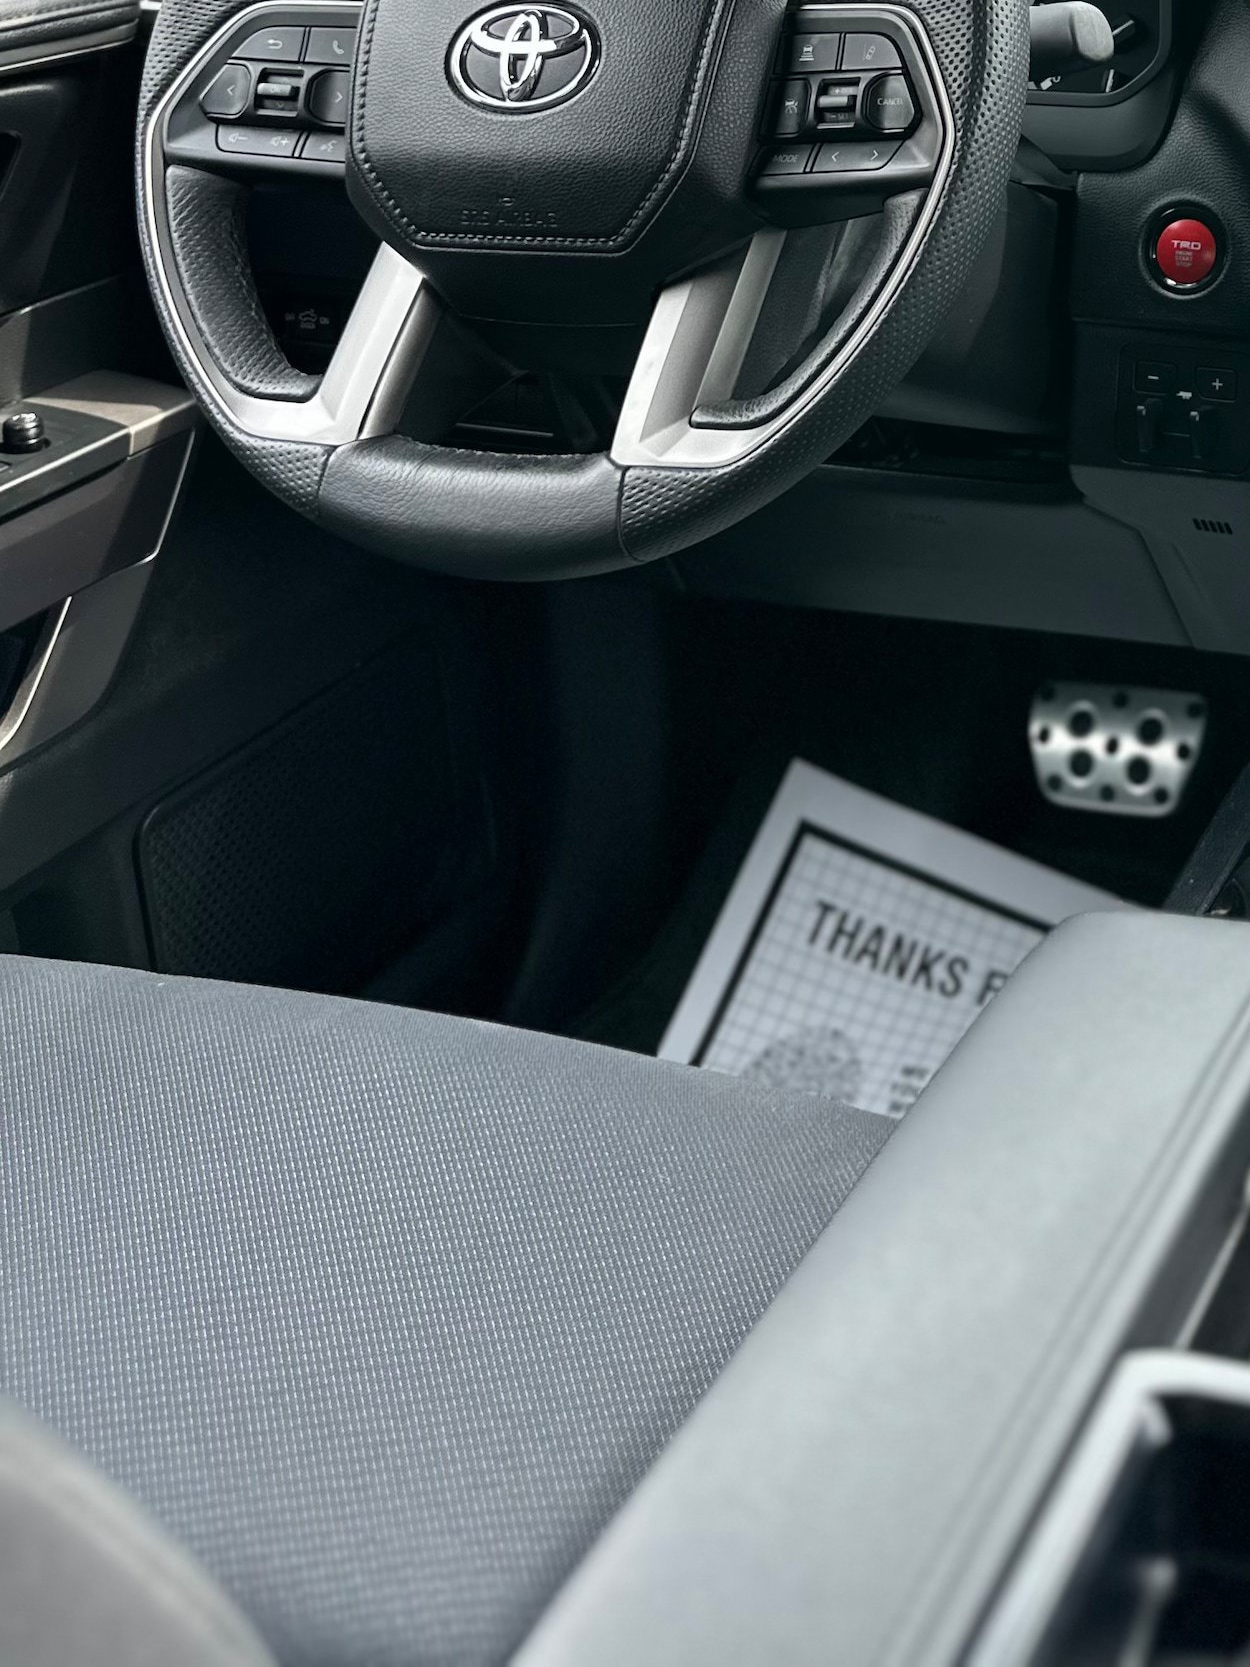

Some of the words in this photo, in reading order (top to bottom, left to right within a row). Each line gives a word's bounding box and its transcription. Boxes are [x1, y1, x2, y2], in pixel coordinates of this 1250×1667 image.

[876, 98, 904, 106] CANCEL
[774, 154, 799, 163] MODE
[461, 210, 490, 226] SRS
[1171, 240, 1201, 250] TRD
[806, 900, 970, 999] THANKS
